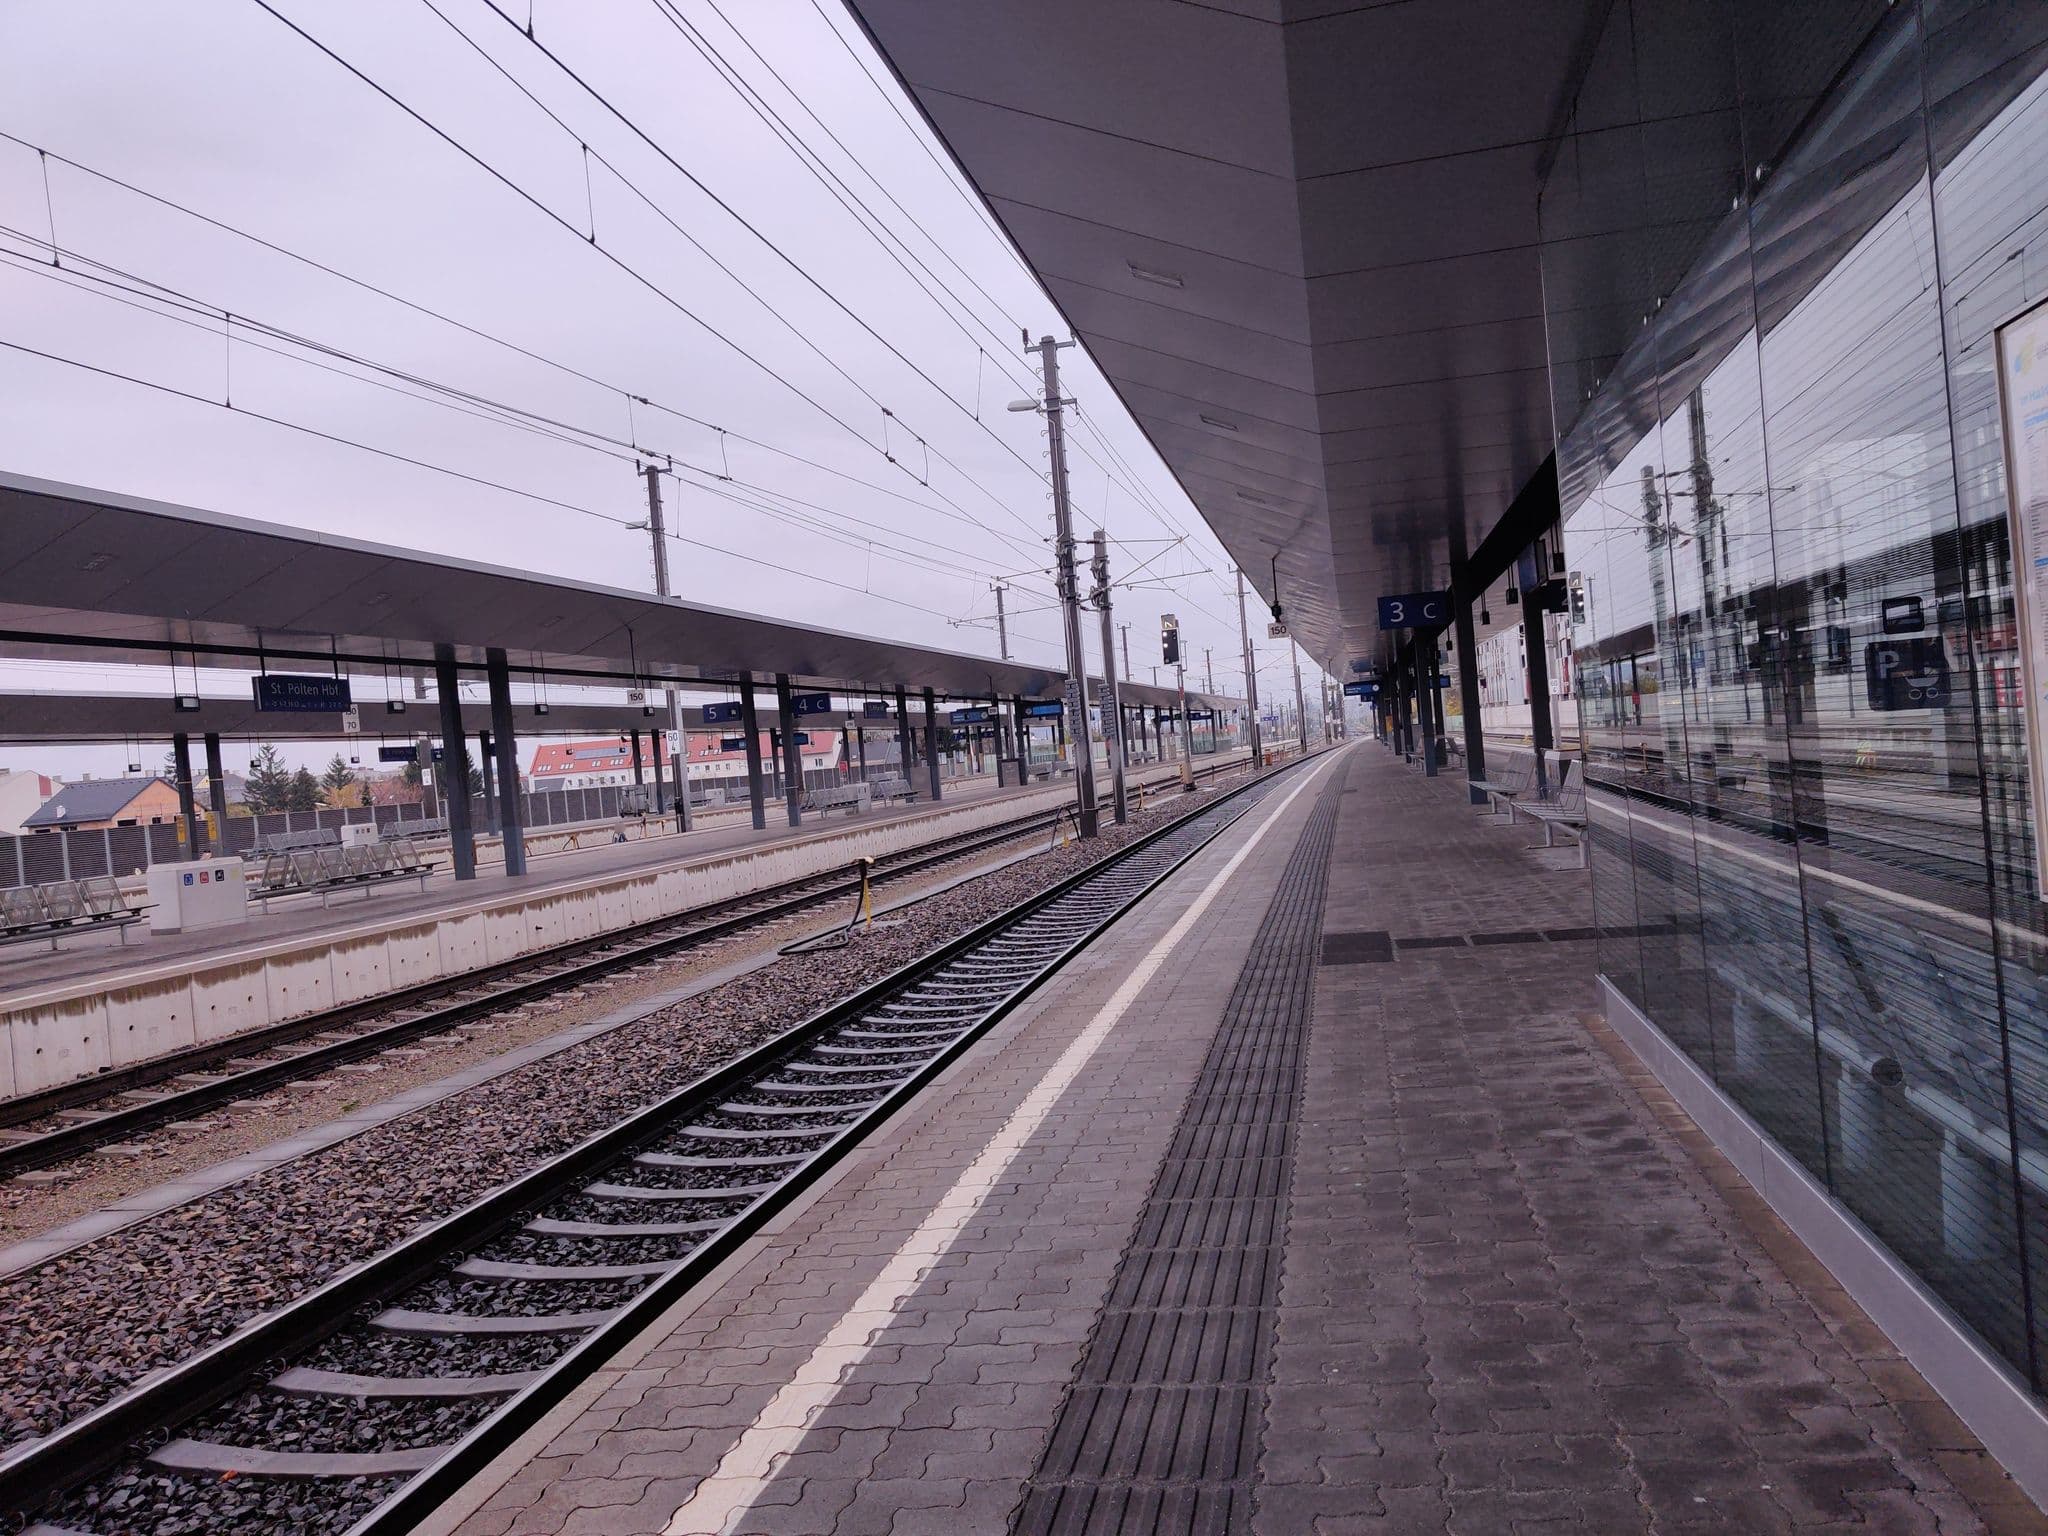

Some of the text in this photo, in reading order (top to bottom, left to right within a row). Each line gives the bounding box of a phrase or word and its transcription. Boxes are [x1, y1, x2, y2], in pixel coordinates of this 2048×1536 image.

[1390, 601, 1437, 623] 3 C
[1270, 625, 1287, 636] 150
[1878, 650, 1900, 679] P
[270, 681, 339, 696] St. Pölten Hbf
[629, 692, 644, 701] 150
[799, 698, 825, 711] 4 C
[708, 706, 717, 720] 5
[346, 721, 357, 729] 70
